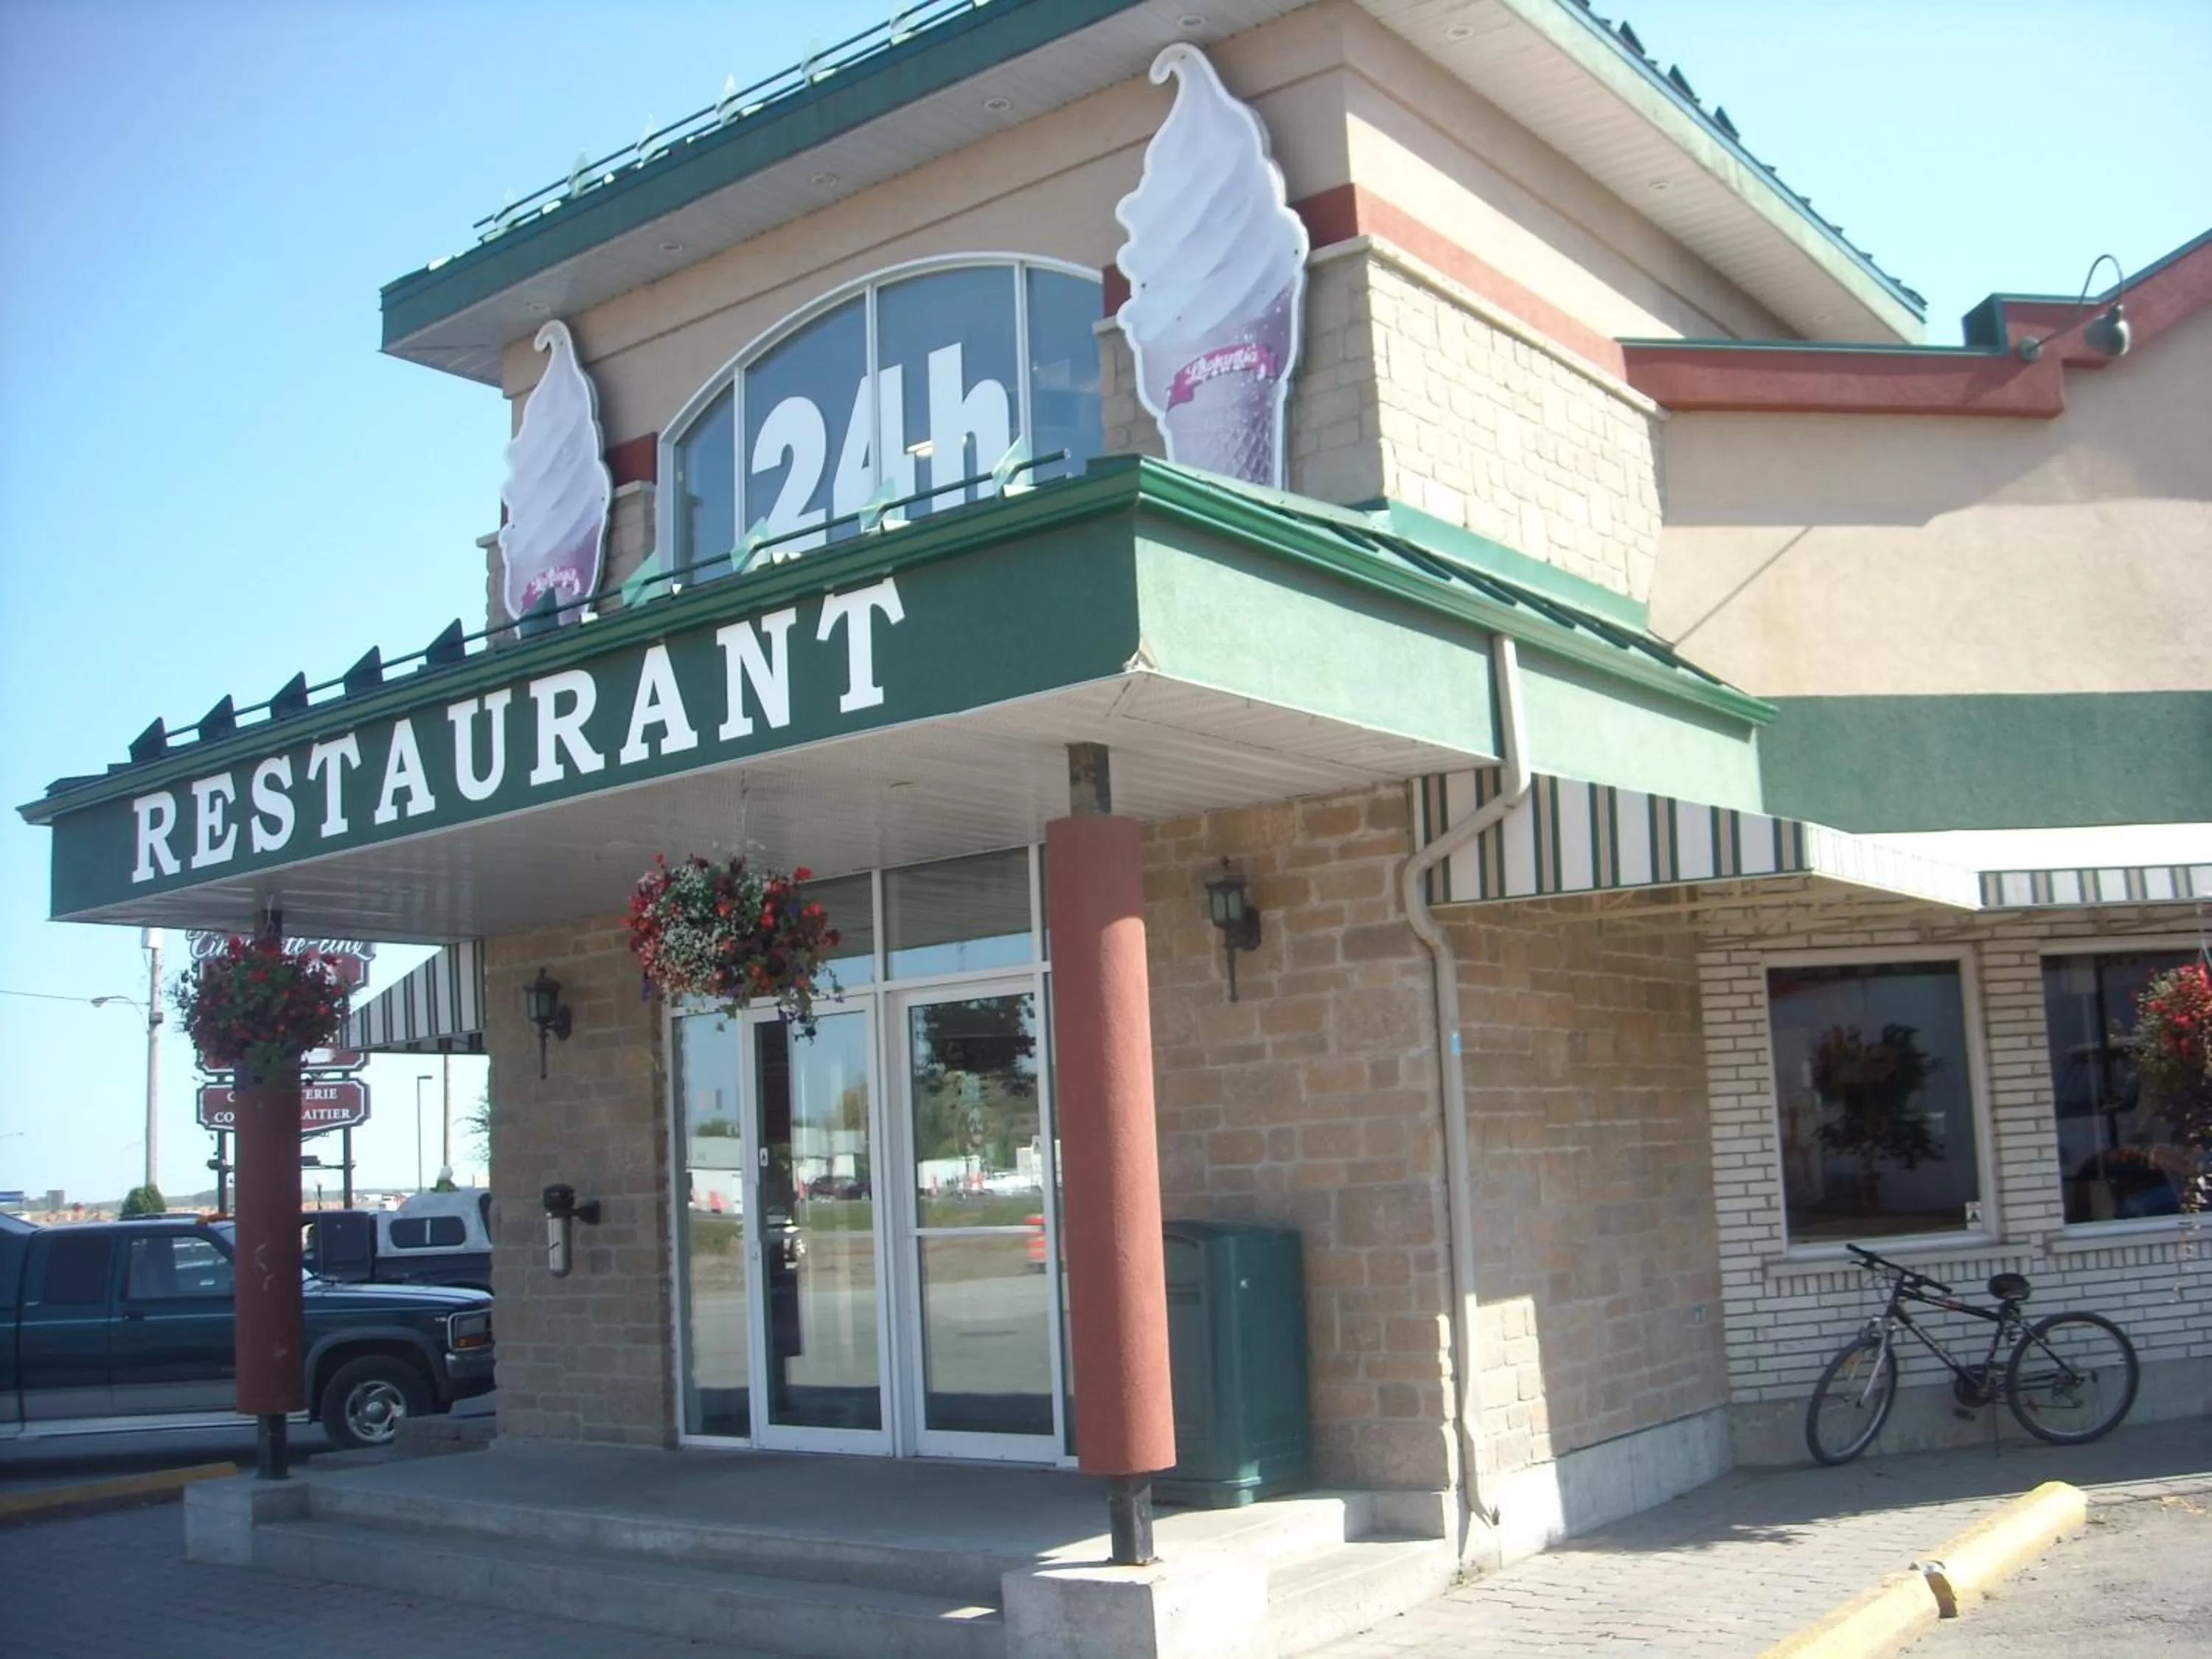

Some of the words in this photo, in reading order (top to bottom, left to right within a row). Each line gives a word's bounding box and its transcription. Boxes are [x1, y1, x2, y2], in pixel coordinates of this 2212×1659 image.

[751, 342, 1009, 554] 24h
[131, 577, 904, 883] RESTAURANT
[300, 1107, 351, 1121] AITIER
